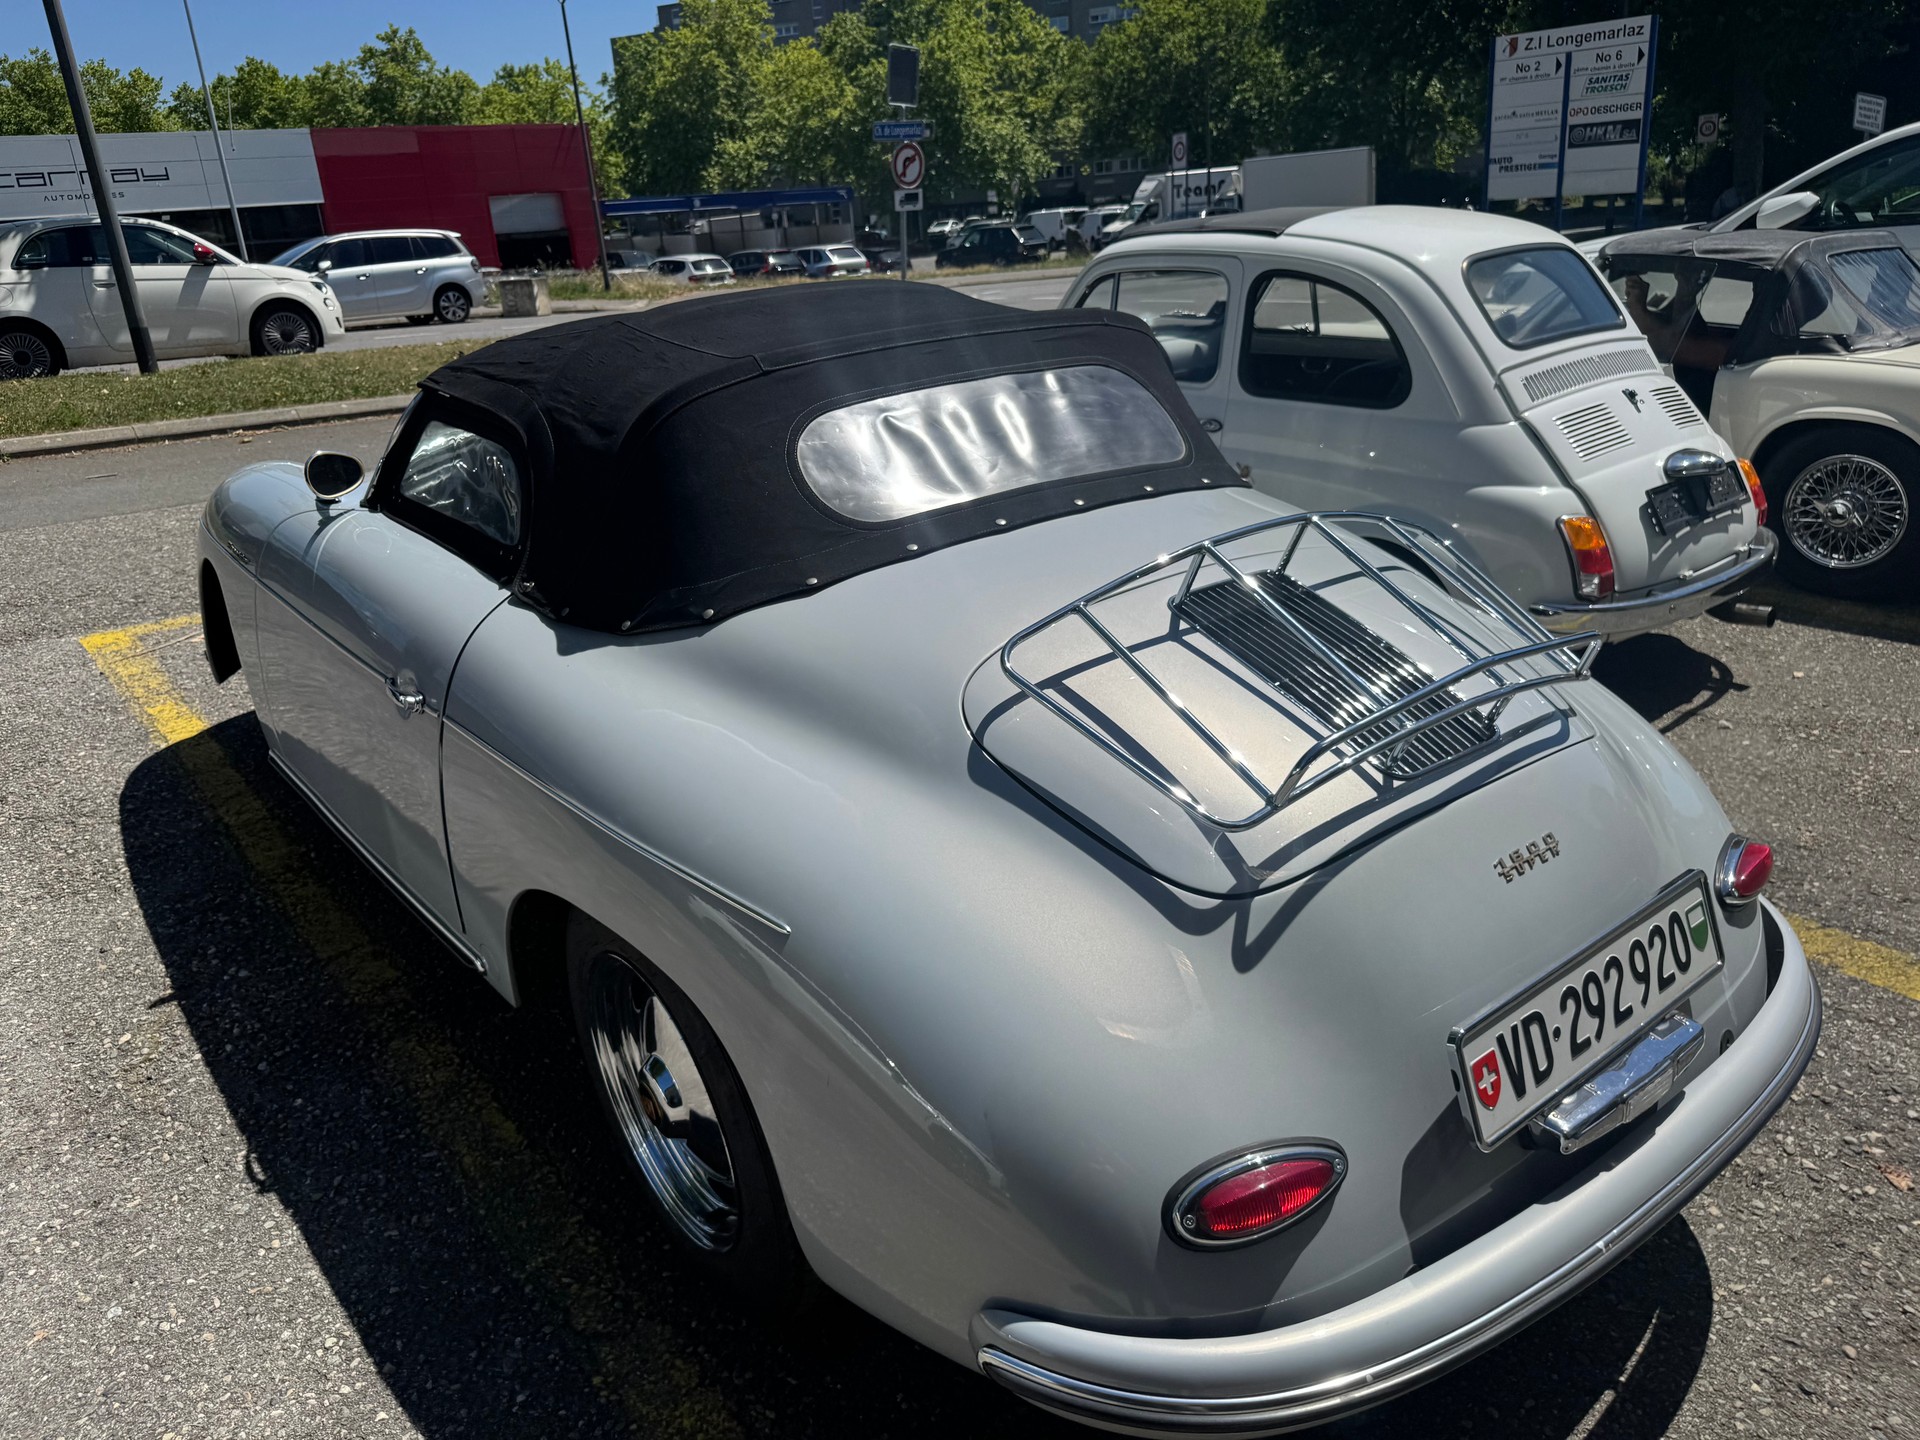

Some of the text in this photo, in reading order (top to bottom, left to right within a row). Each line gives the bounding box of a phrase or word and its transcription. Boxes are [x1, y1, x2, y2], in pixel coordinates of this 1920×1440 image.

[1524, 24, 1645, 51] Z.I Longemarlaz
[1595, 49, 1623, 63] No 6
[1515, 60, 1541, 74] No 2
[1587, 73, 1631, 85] SANITAS
[1585, 82, 1628, 94] TROESCH
[1569, 102, 1642, 117] OPO OESCHGER
[1584, 124, 1638, 141] HKM SA
[1499, 163, 1538, 173] PRESTIGE
[43, 191, 125, 202] AUTOMOES
[1493, 831, 1556, 869] 1600
[1498, 840, 1560, 884] SUPER
